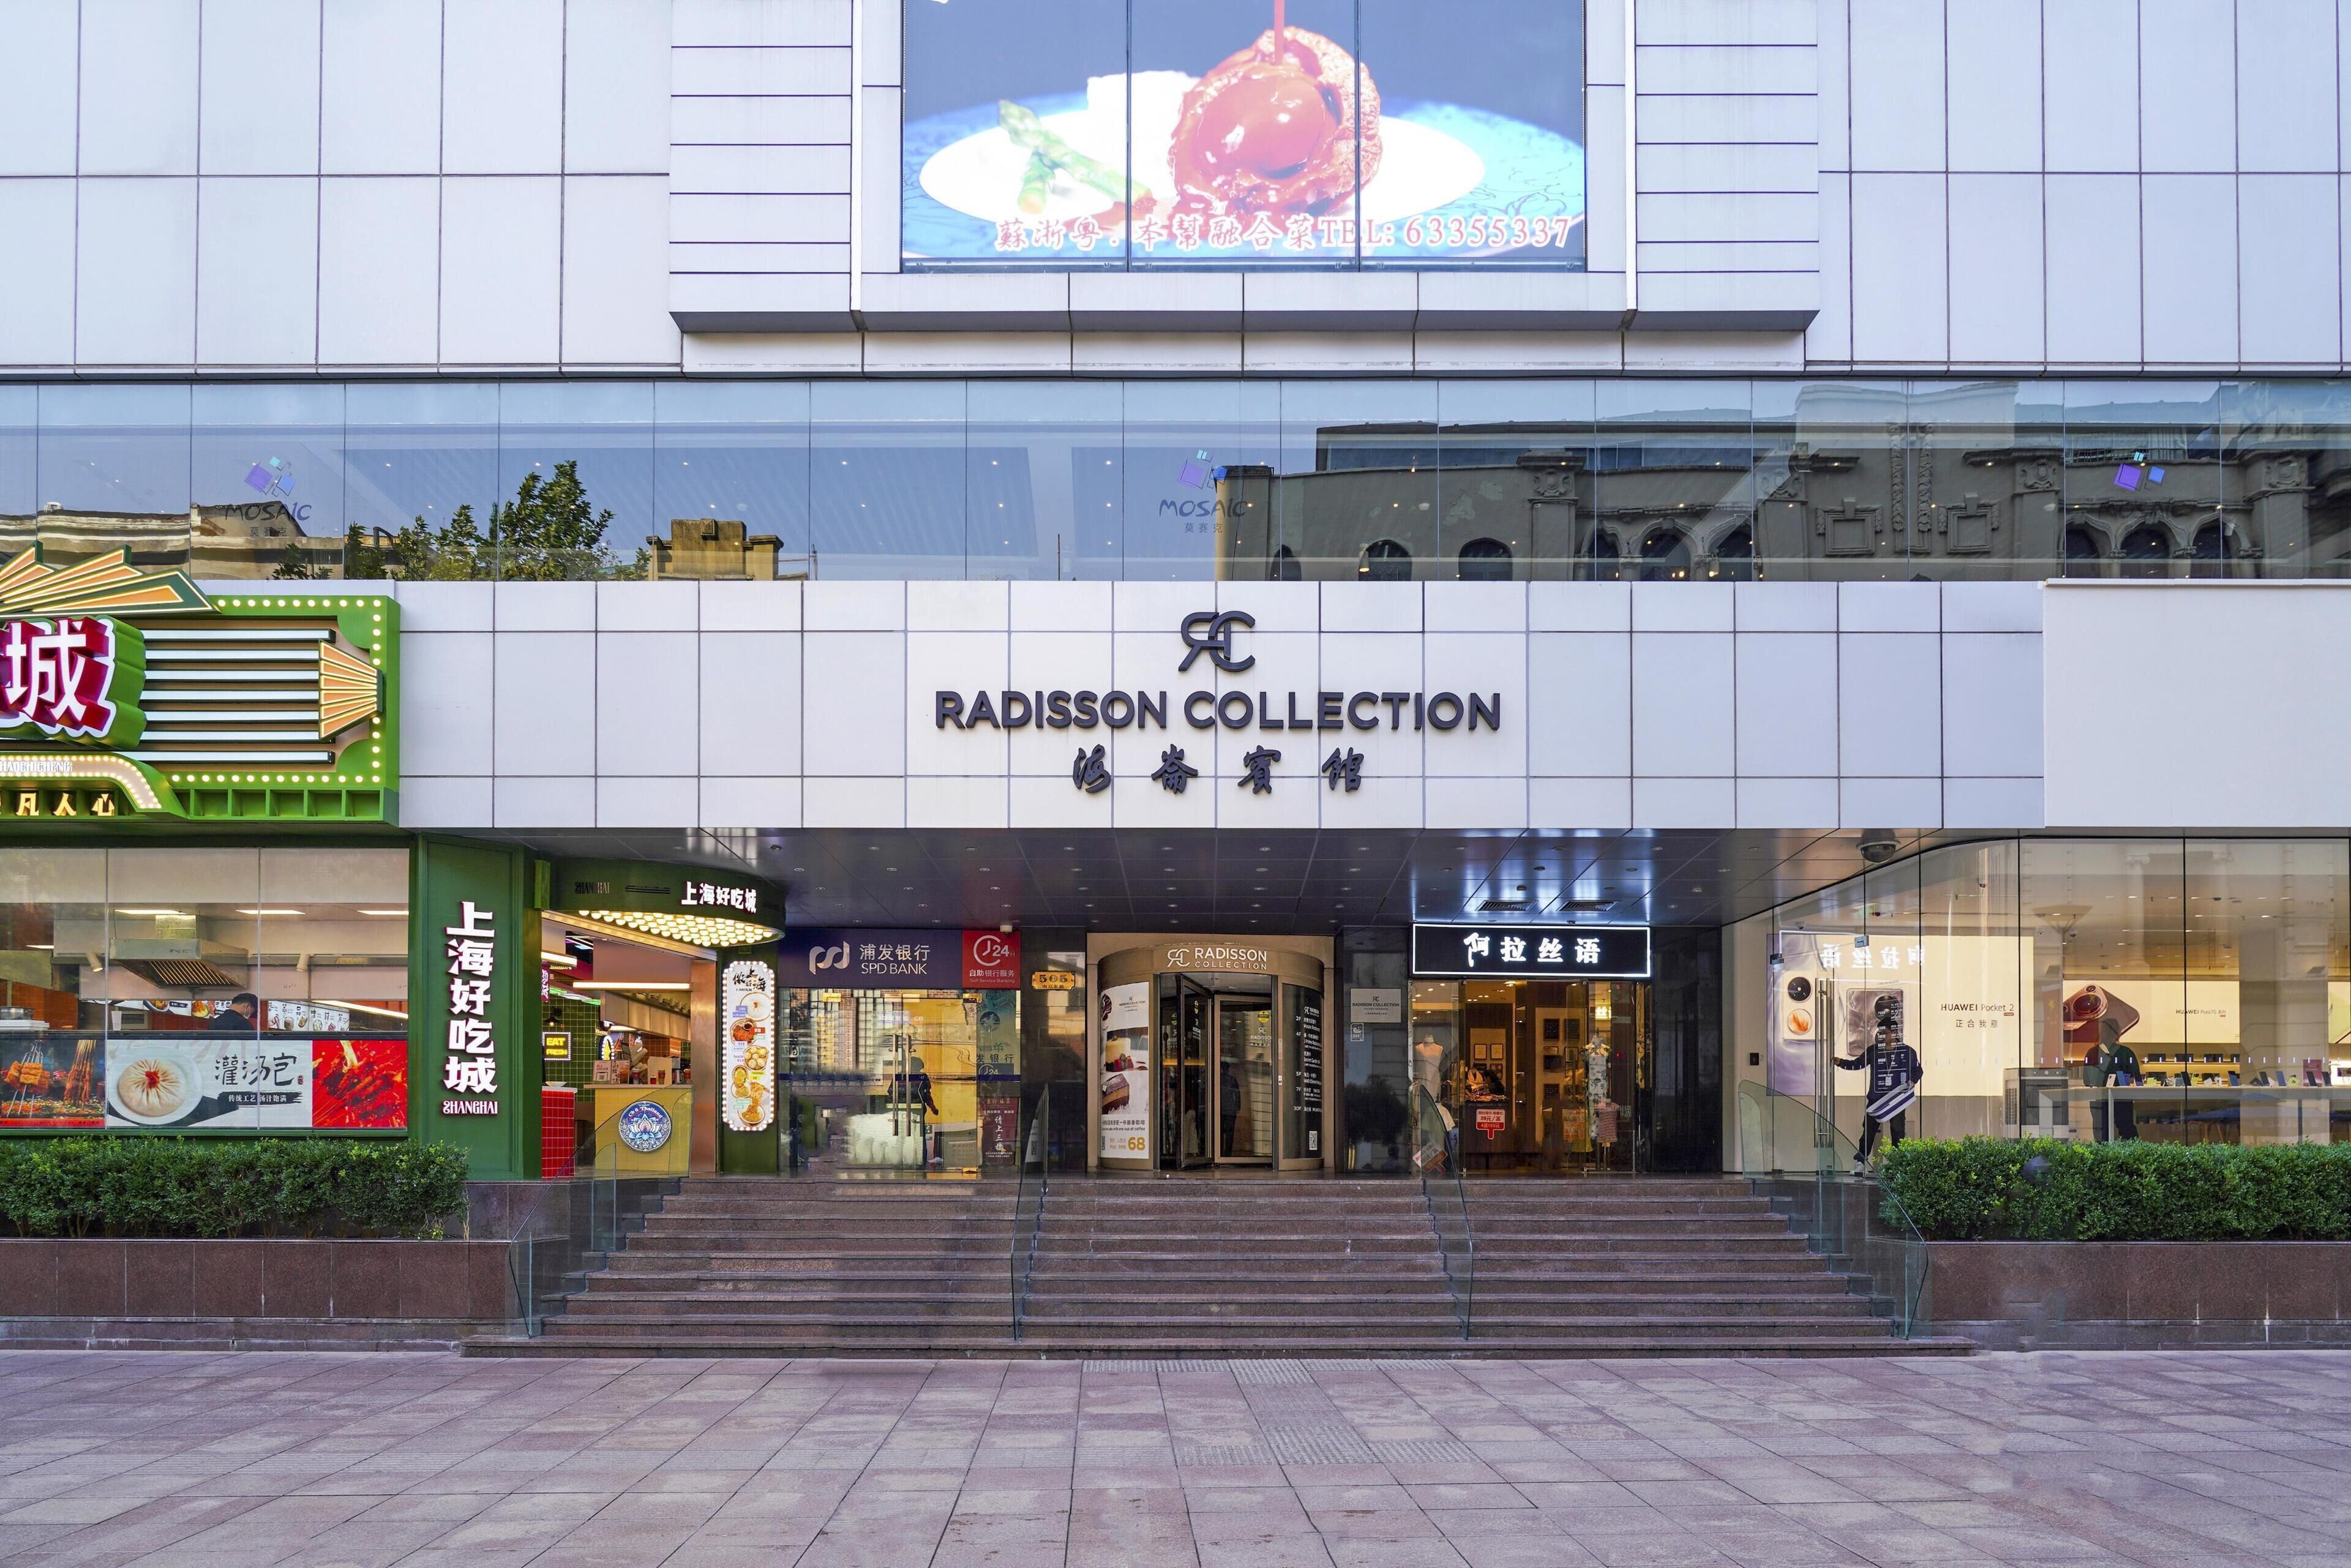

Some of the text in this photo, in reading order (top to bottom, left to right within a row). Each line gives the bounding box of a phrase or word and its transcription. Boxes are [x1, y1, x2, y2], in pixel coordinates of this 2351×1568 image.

[1405, 217, 1570, 247] 63355337
[225, 501, 312, 521] MOSAIC
[1159, 498, 1248, 517] MOSAIC
[1184, 522, 1223, 533] 莫赛克
[2, 618, 89, 722] 城
[936, 690, 1501, 731] RADISSON COLLECTION
[0, 792, 115, 816] 凡人心
[681, 880, 757, 913] 上海好吃城
[860, 944, 931, 961] 浦发银行
[1194, 947, 1267, 962] RADISSON
[1463, 932, 1601, 968] 阿拉丝语
[861, 963, 928, 975] SPD BANK
[1194, 961, 1267, 970] COLLECTION
[969, 969, 1015, 978] 自助银行服务
[1039, 974, 1068, 983] 505
[442, 900, 498, 1094] 上海好吃城
[1955, 1019, 1998, 1028] 正合我意
[546, 1037, 566, 1046] EAT
[442, 1100, 498, 1115] SHANGHAI
[640, 1106, 663, 1119] Thailand
[1128, 1136, 1146, 1151] 68
